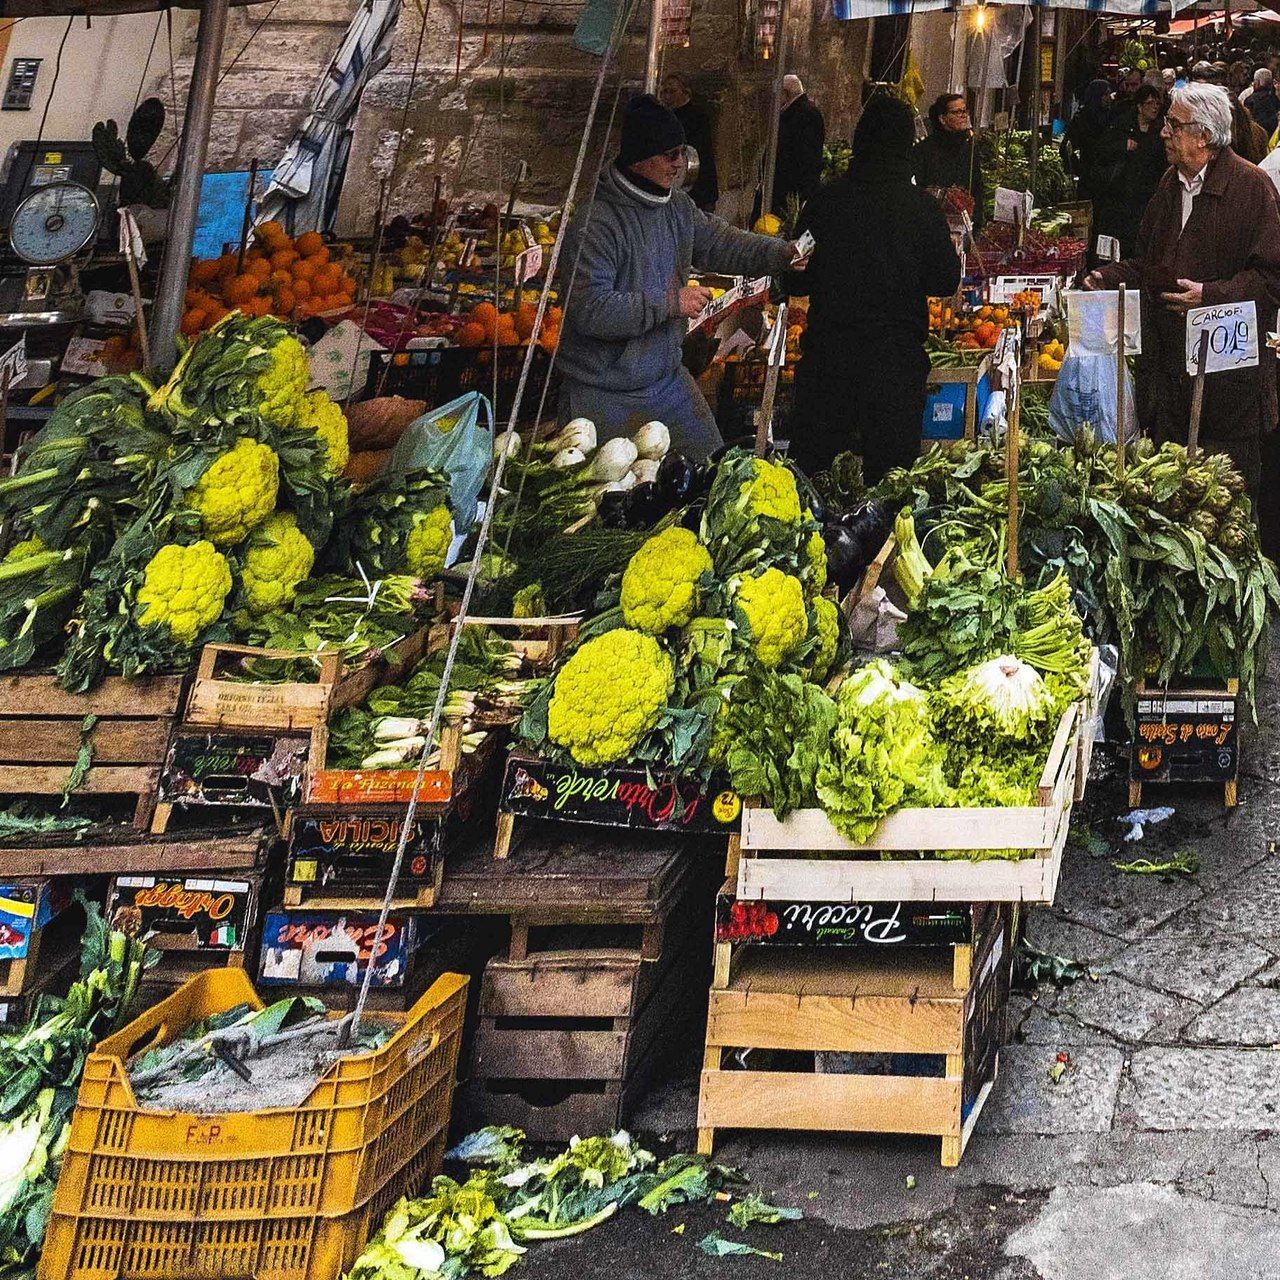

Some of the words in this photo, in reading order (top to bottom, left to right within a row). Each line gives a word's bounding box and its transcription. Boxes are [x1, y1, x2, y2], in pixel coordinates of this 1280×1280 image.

[720, 793, 735, 807] 72
[319, 820, 416, 844] SICILIA
[134, 882, 235, 920] Ortaggi
[784, 901, 907, 943] Picceri
